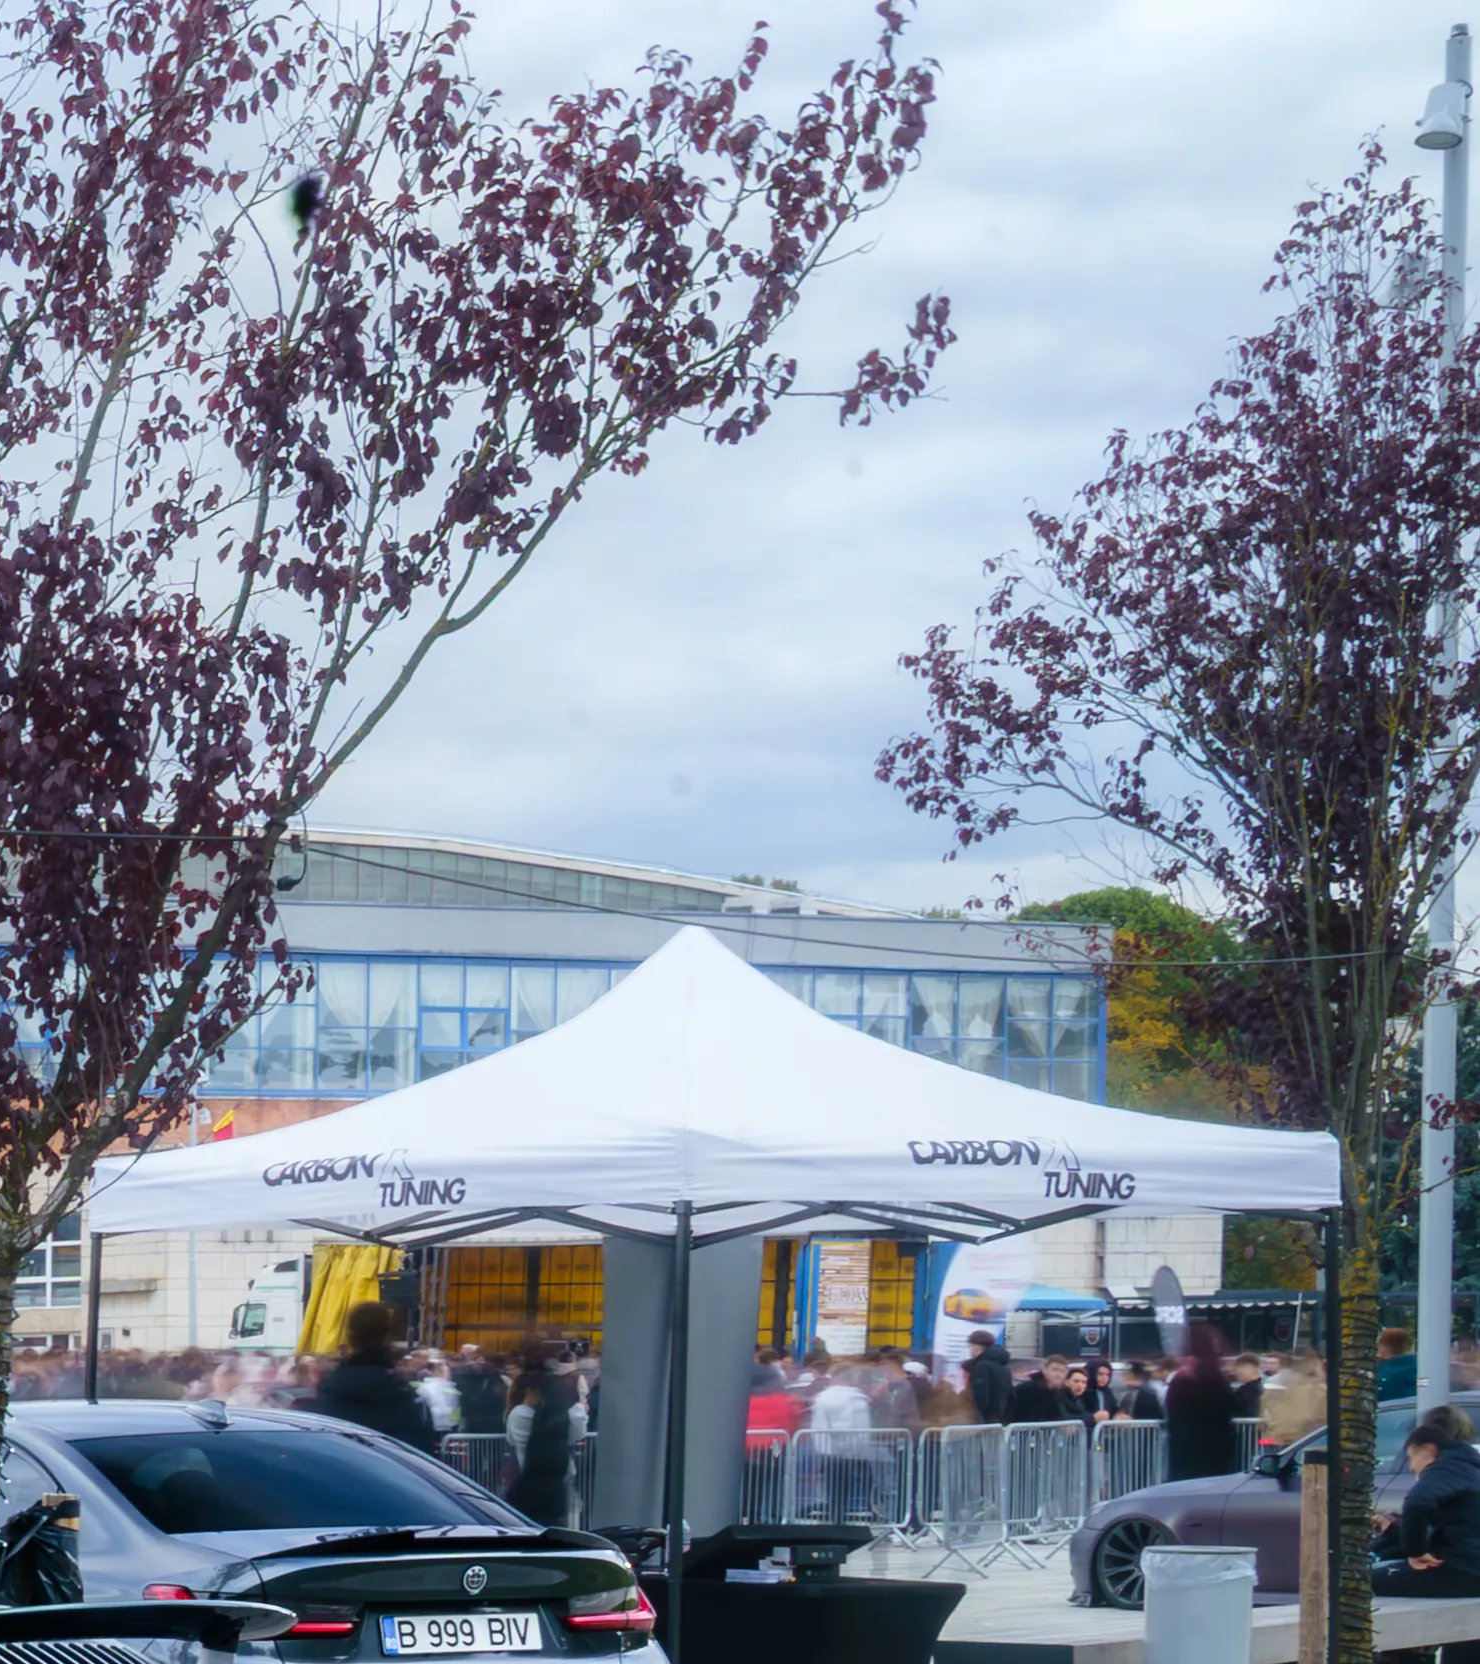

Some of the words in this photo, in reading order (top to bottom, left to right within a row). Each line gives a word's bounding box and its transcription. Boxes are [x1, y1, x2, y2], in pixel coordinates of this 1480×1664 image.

[908, 1140, 1042, 1165] CARBON
[263, 1153, 384, 1186] CARBON
[379, 1178, 466, 1207] TUNING
[1044, 1172, 1136, 1199] TUNING
[397, 1620, 417, 1648] B
[427, 1618, 475, 1647] 999
[487, 1617, 529, 1646] BIV
